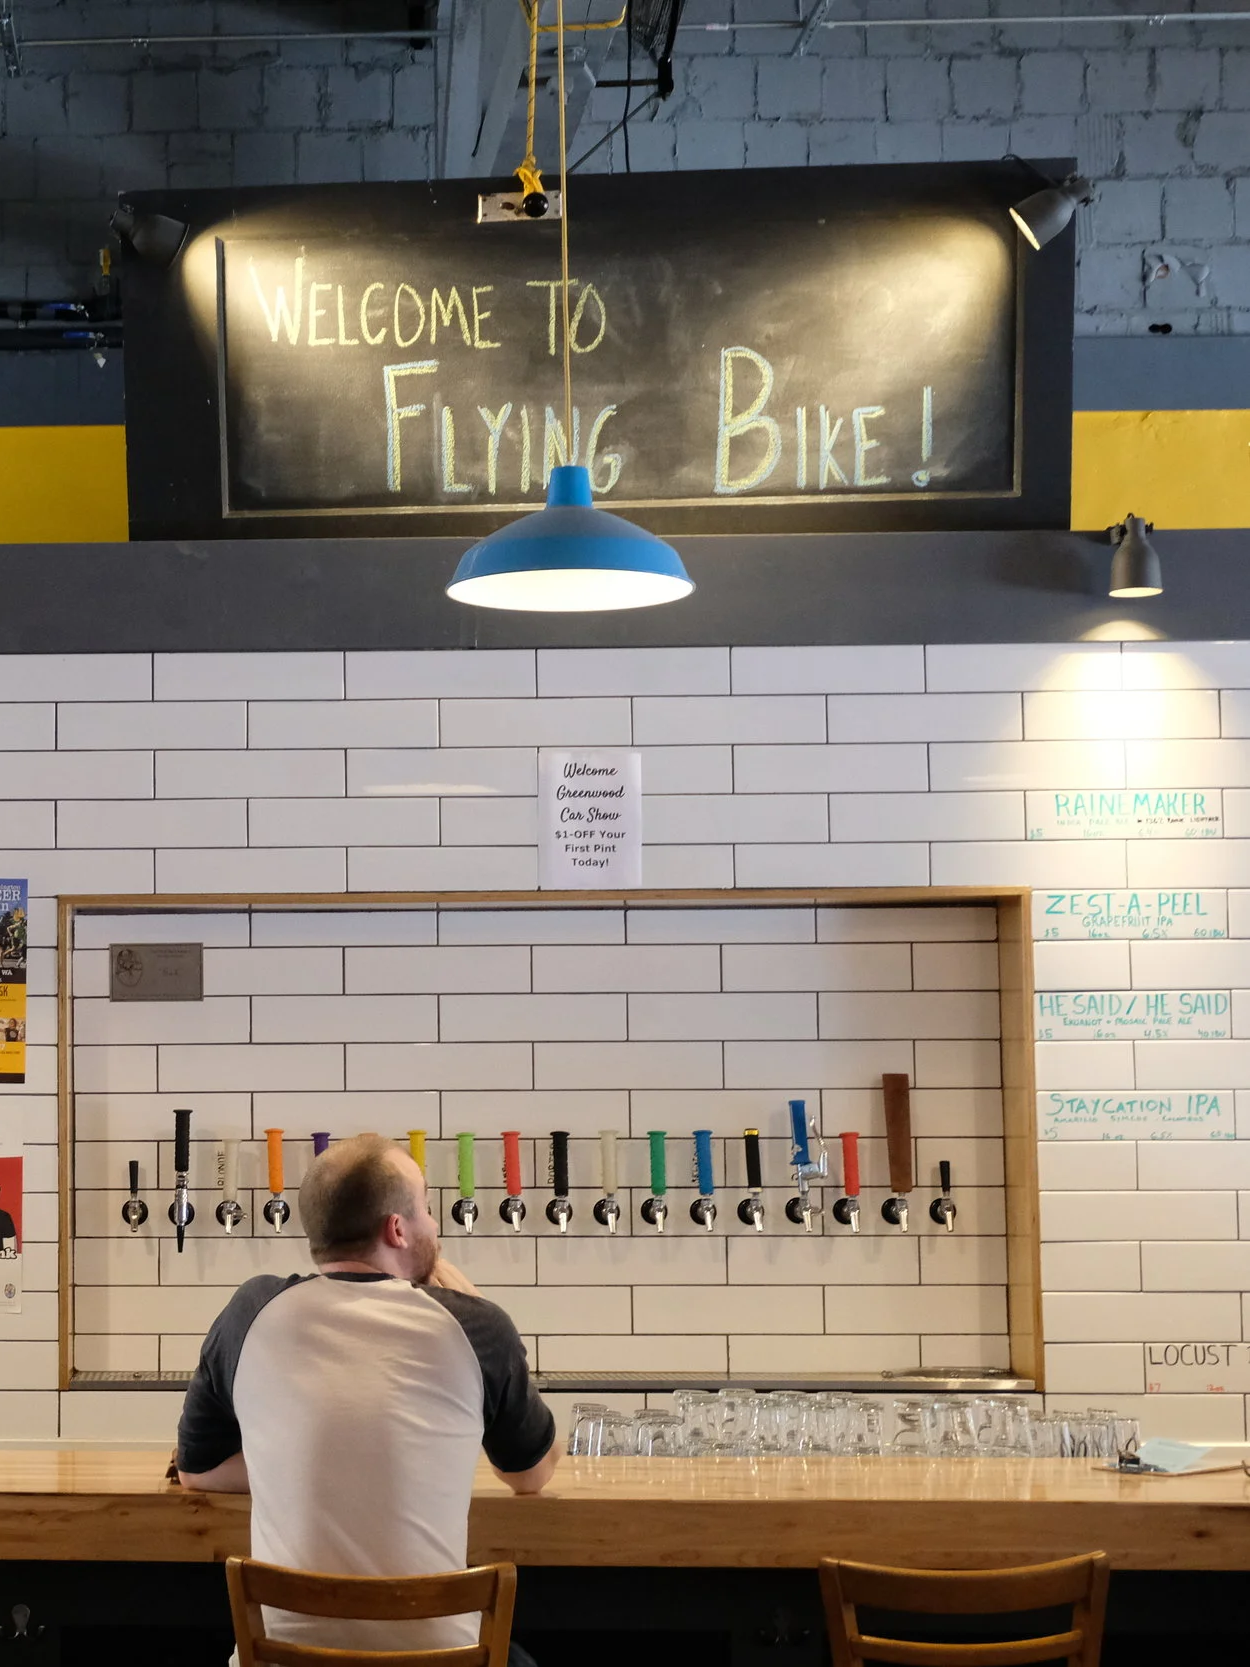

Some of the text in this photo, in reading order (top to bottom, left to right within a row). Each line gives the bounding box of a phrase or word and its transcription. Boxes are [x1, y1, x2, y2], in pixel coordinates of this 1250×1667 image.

[250, 245, 606, 355] WELCOME TO
[382, 359, 623, 495] FLYING
[563, 762, 618, 778] Welcome
[556, 784, 625, 800] Greenwood
[560, 807, 621, 823] Car Show
[555, 830, 626, 839] $1-OFF Your
[565, 844, 617, 852] First Pint
[571, 858, 609, 868] Today!
[1045, 893, 1208, 916] ZEST-A-PEEL
[1082, 915, 1173, 927] GRAPEFRUIT IPA
[1039, 994, 1067, 1017] HE
[1146, 993, 1171, 1016] HE
[1179, 993, 1228, 1016] SAID
[1178, 1017, 1192, 1025] ALE
[1046, 1093, 1221, 1116] STAYCATION IPA
[1149, 1344, 1238, 1367] LOCUST
